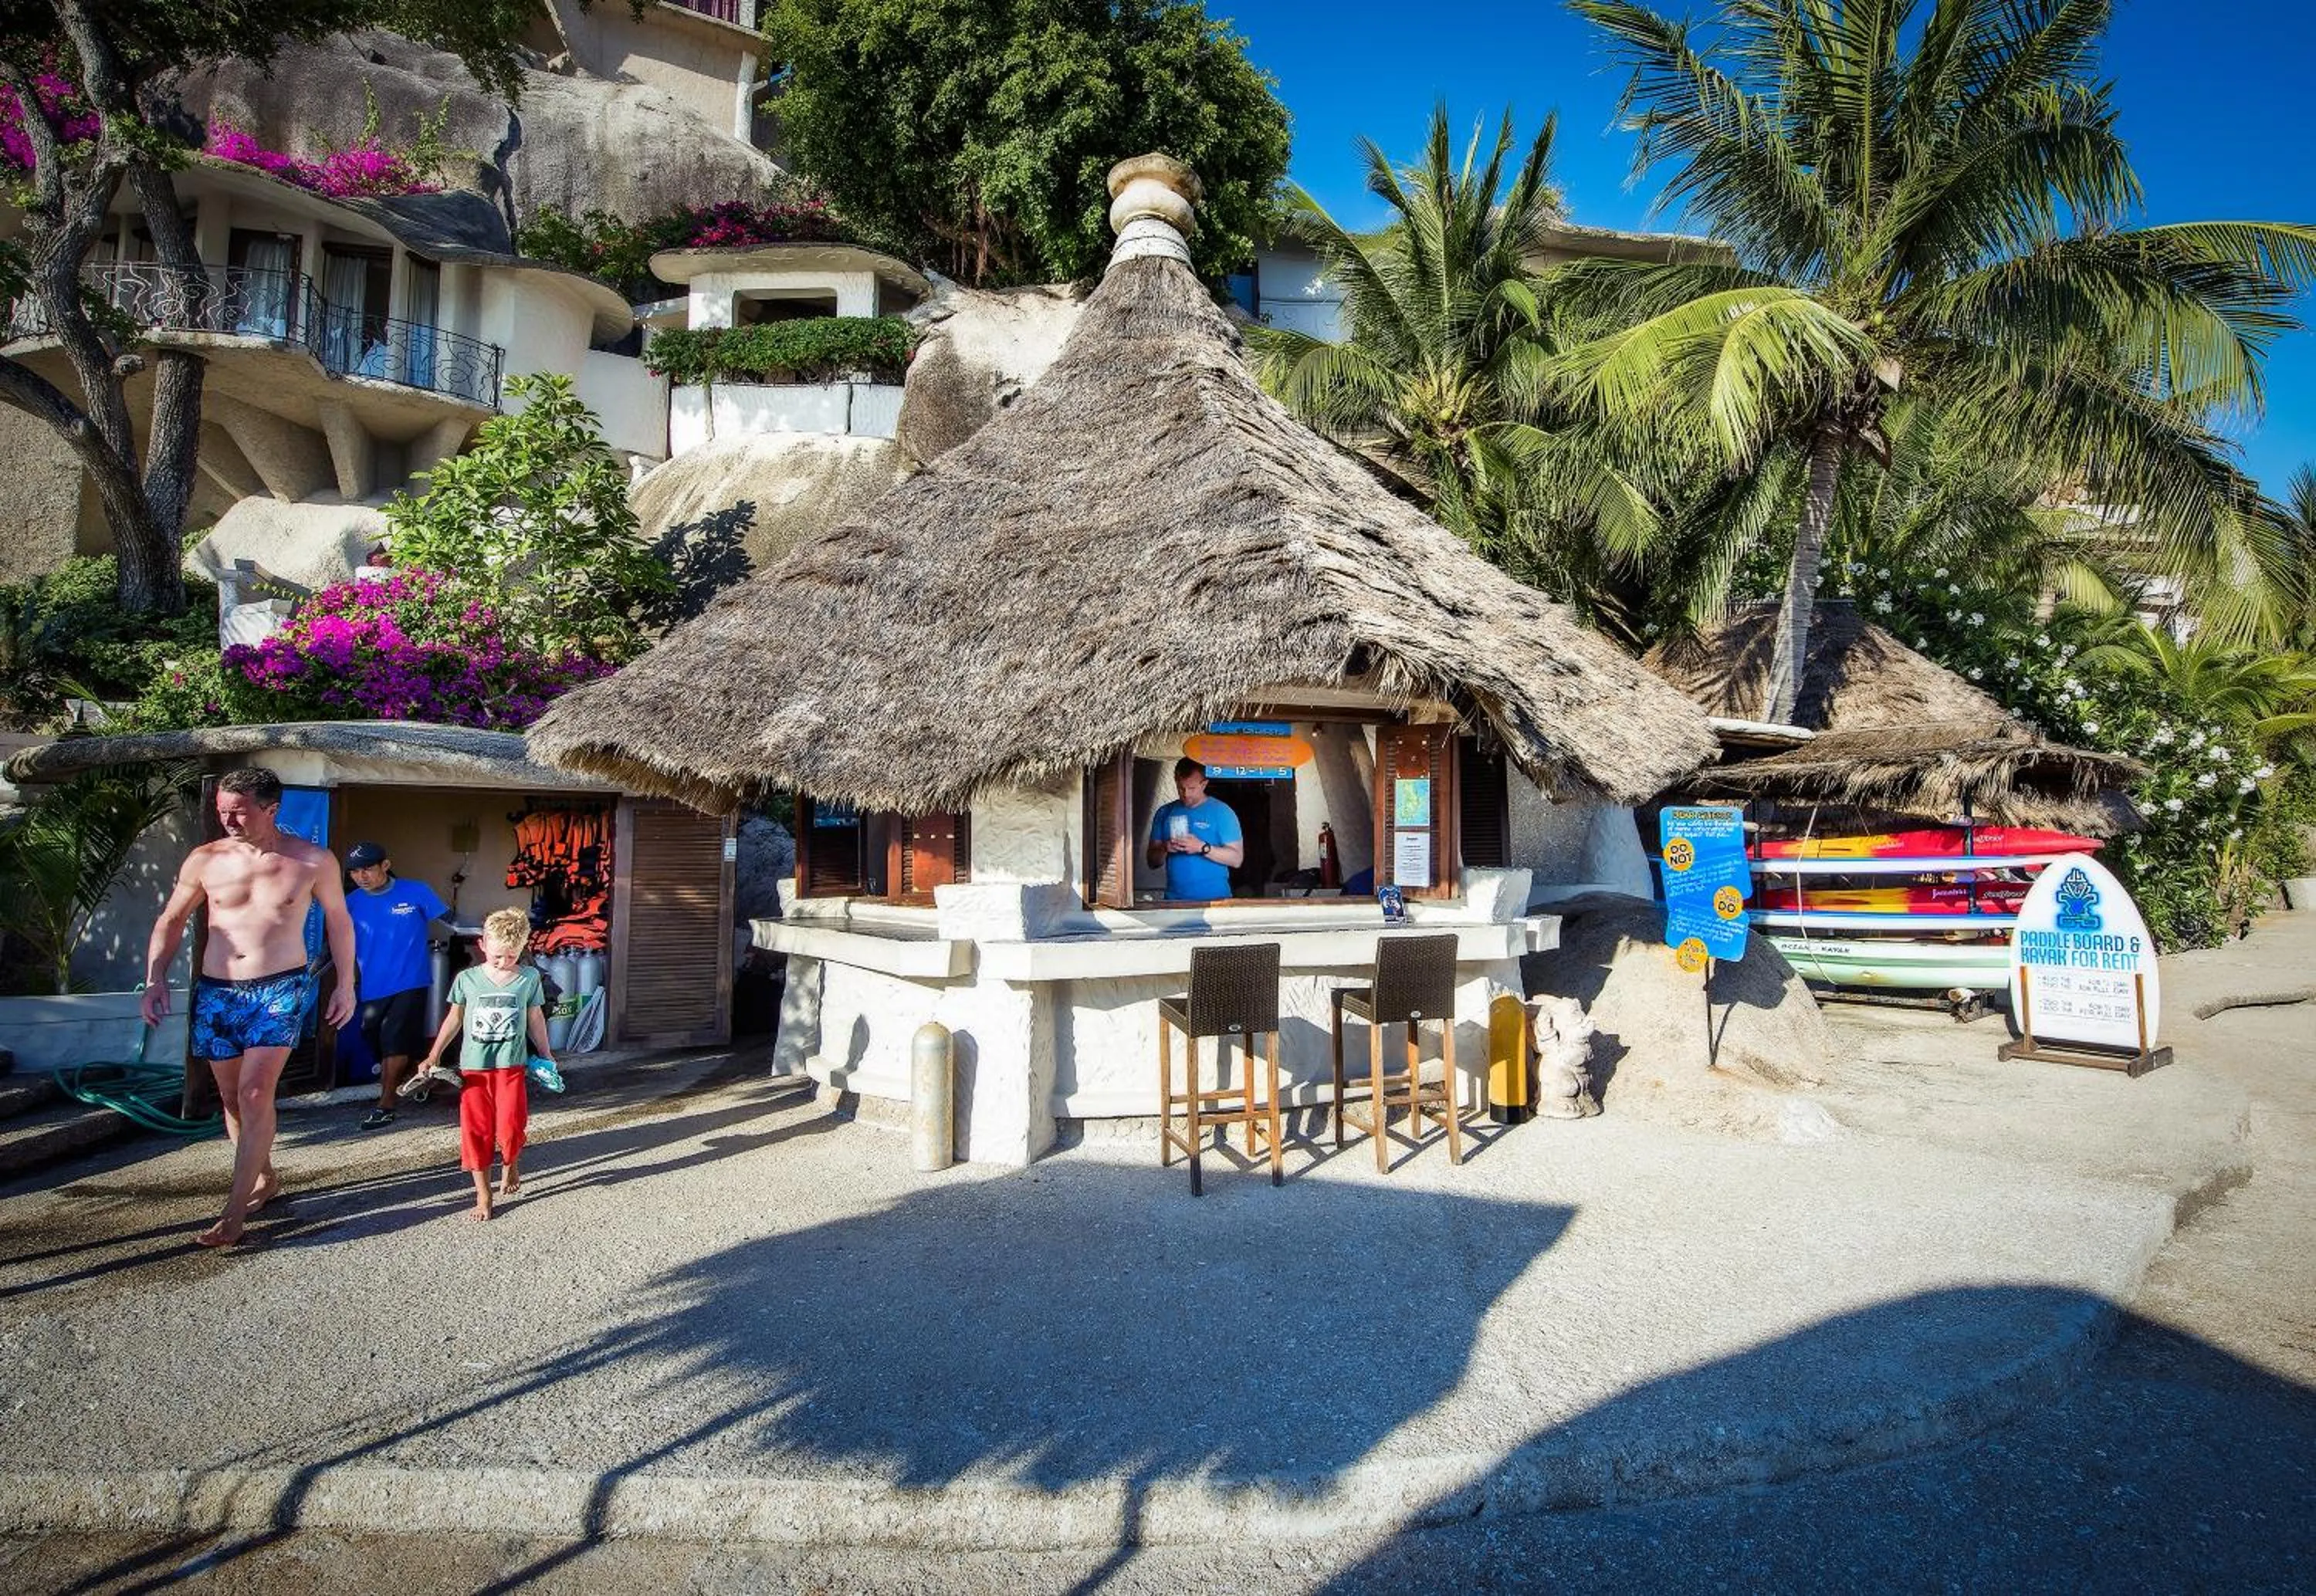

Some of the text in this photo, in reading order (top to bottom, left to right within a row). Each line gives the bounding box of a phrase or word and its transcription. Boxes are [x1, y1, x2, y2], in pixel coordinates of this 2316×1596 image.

[1278, 766, 1287, 775] 5
[1671, 844, 1688, 854] DO
[1670, 852, 1692, 864] NOT
[1718, 901, 1735, 913] DO
[2020, 930, 2141, 952] PADDLE BOARD &
[2020, 947, 2139, 970] KAYAK FOR RENT
